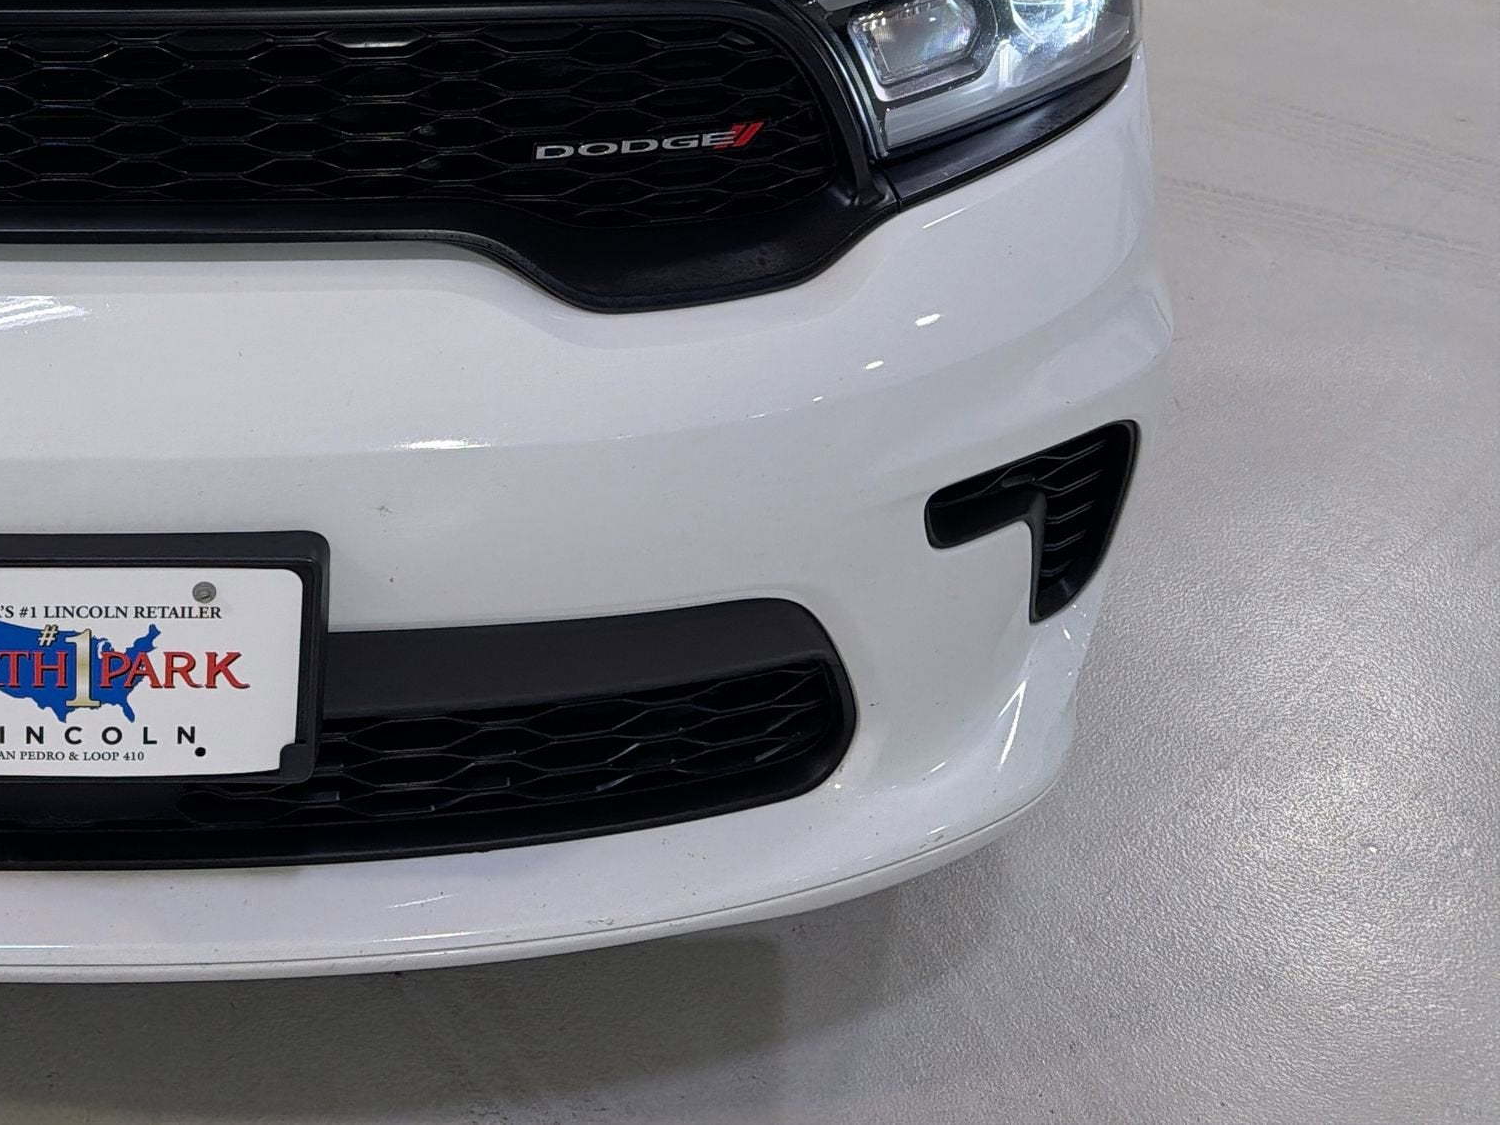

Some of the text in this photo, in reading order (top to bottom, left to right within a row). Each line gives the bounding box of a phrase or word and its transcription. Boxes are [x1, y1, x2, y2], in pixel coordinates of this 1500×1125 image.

[535, 131, 737, 160] DODGE
[18, 606, 37, 619] #1
[43, 605, 128, 619] LINCOLN
[133, 605, 222, 619] RETAILER
[100, 651, 251, 690] PARK
[20, 750, 65, 761] PEDRO
[69, 751, 80, 761] &
[83, 751, 119, 761] LOOP
[123, 751, 145, 761] 410
